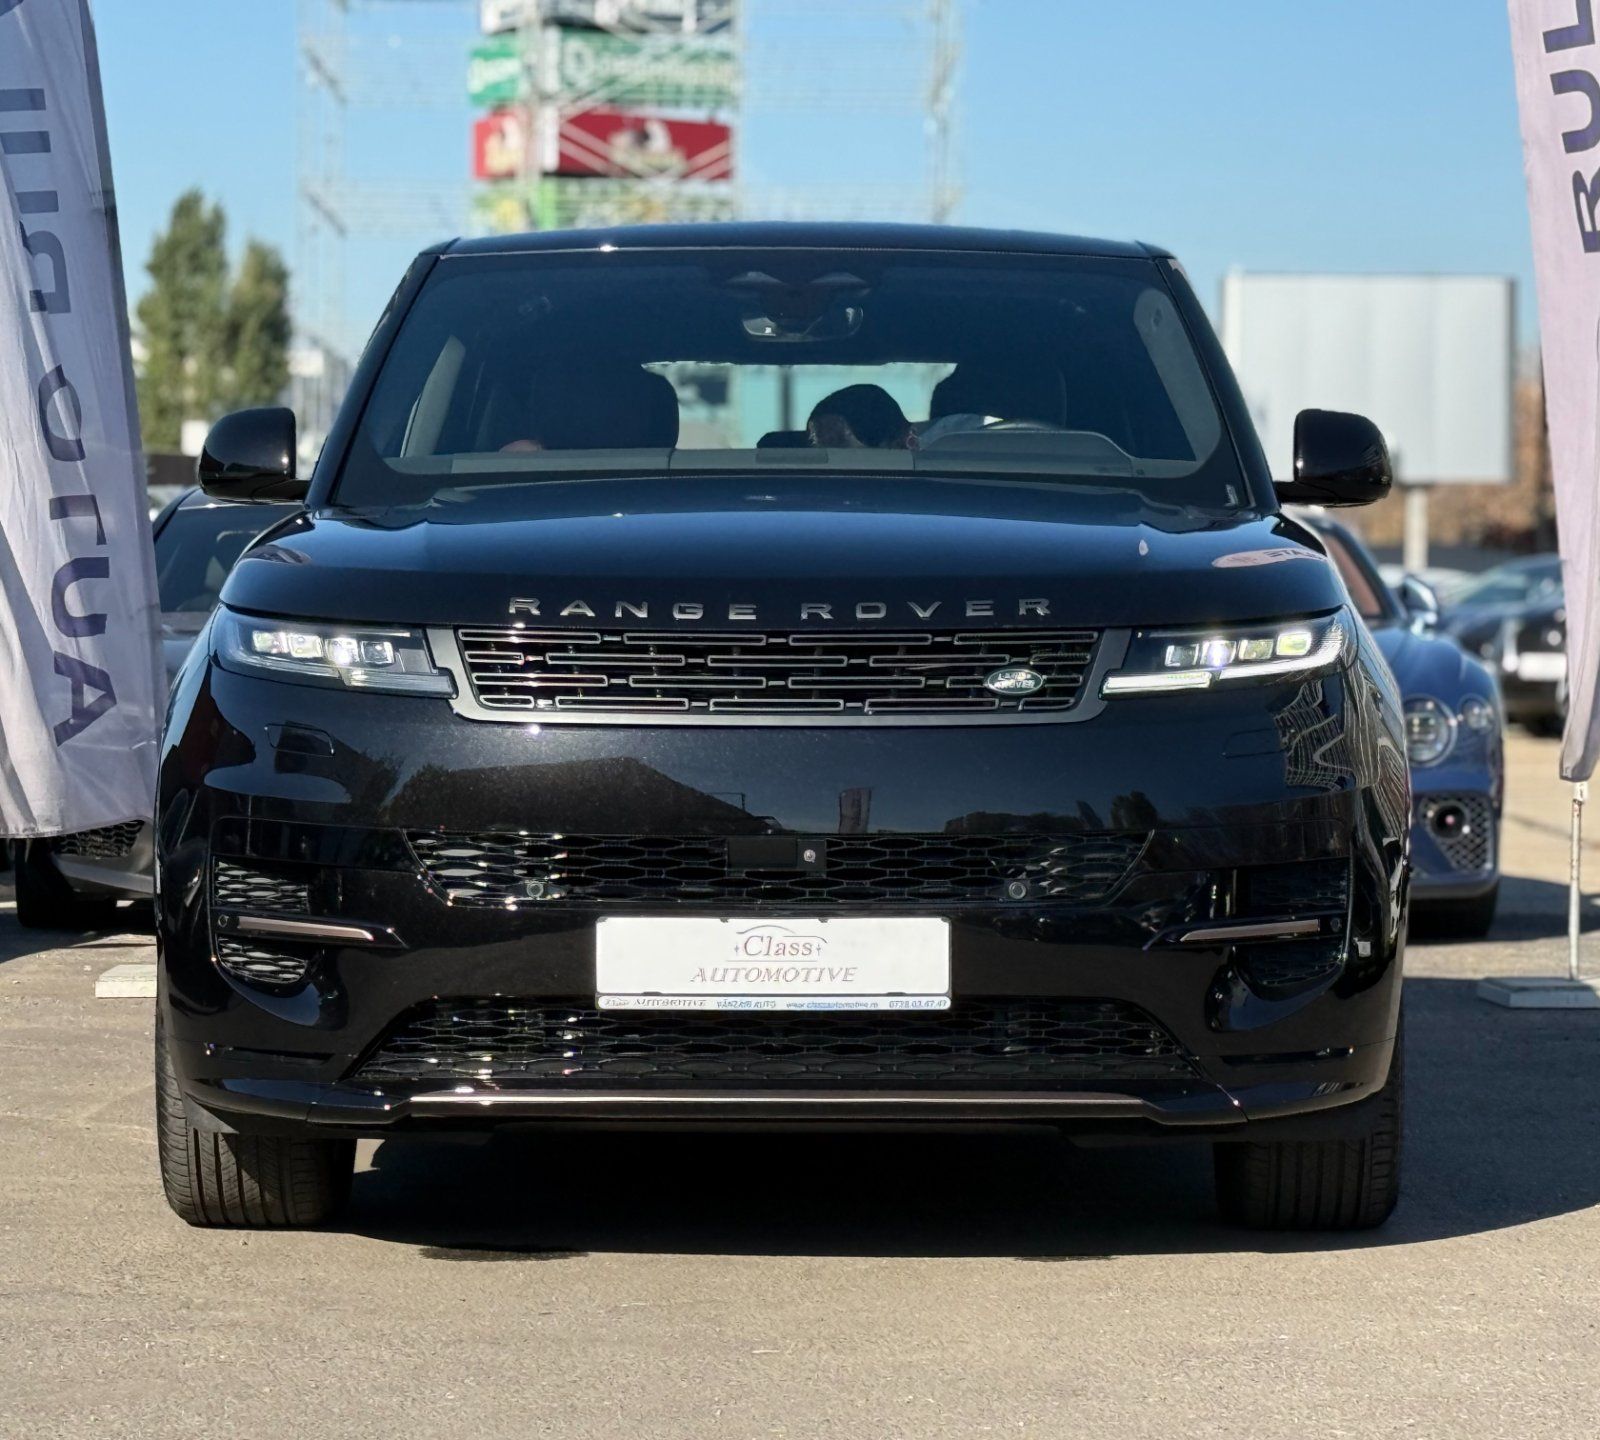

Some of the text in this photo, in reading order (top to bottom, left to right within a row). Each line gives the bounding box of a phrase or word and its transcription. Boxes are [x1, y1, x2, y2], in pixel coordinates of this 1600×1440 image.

[508, 597, 1051, 620] RANGE ROVER
[743, 936, 813, 957] Class
[690, 967, 858, 983] AUTOMOTIVE
